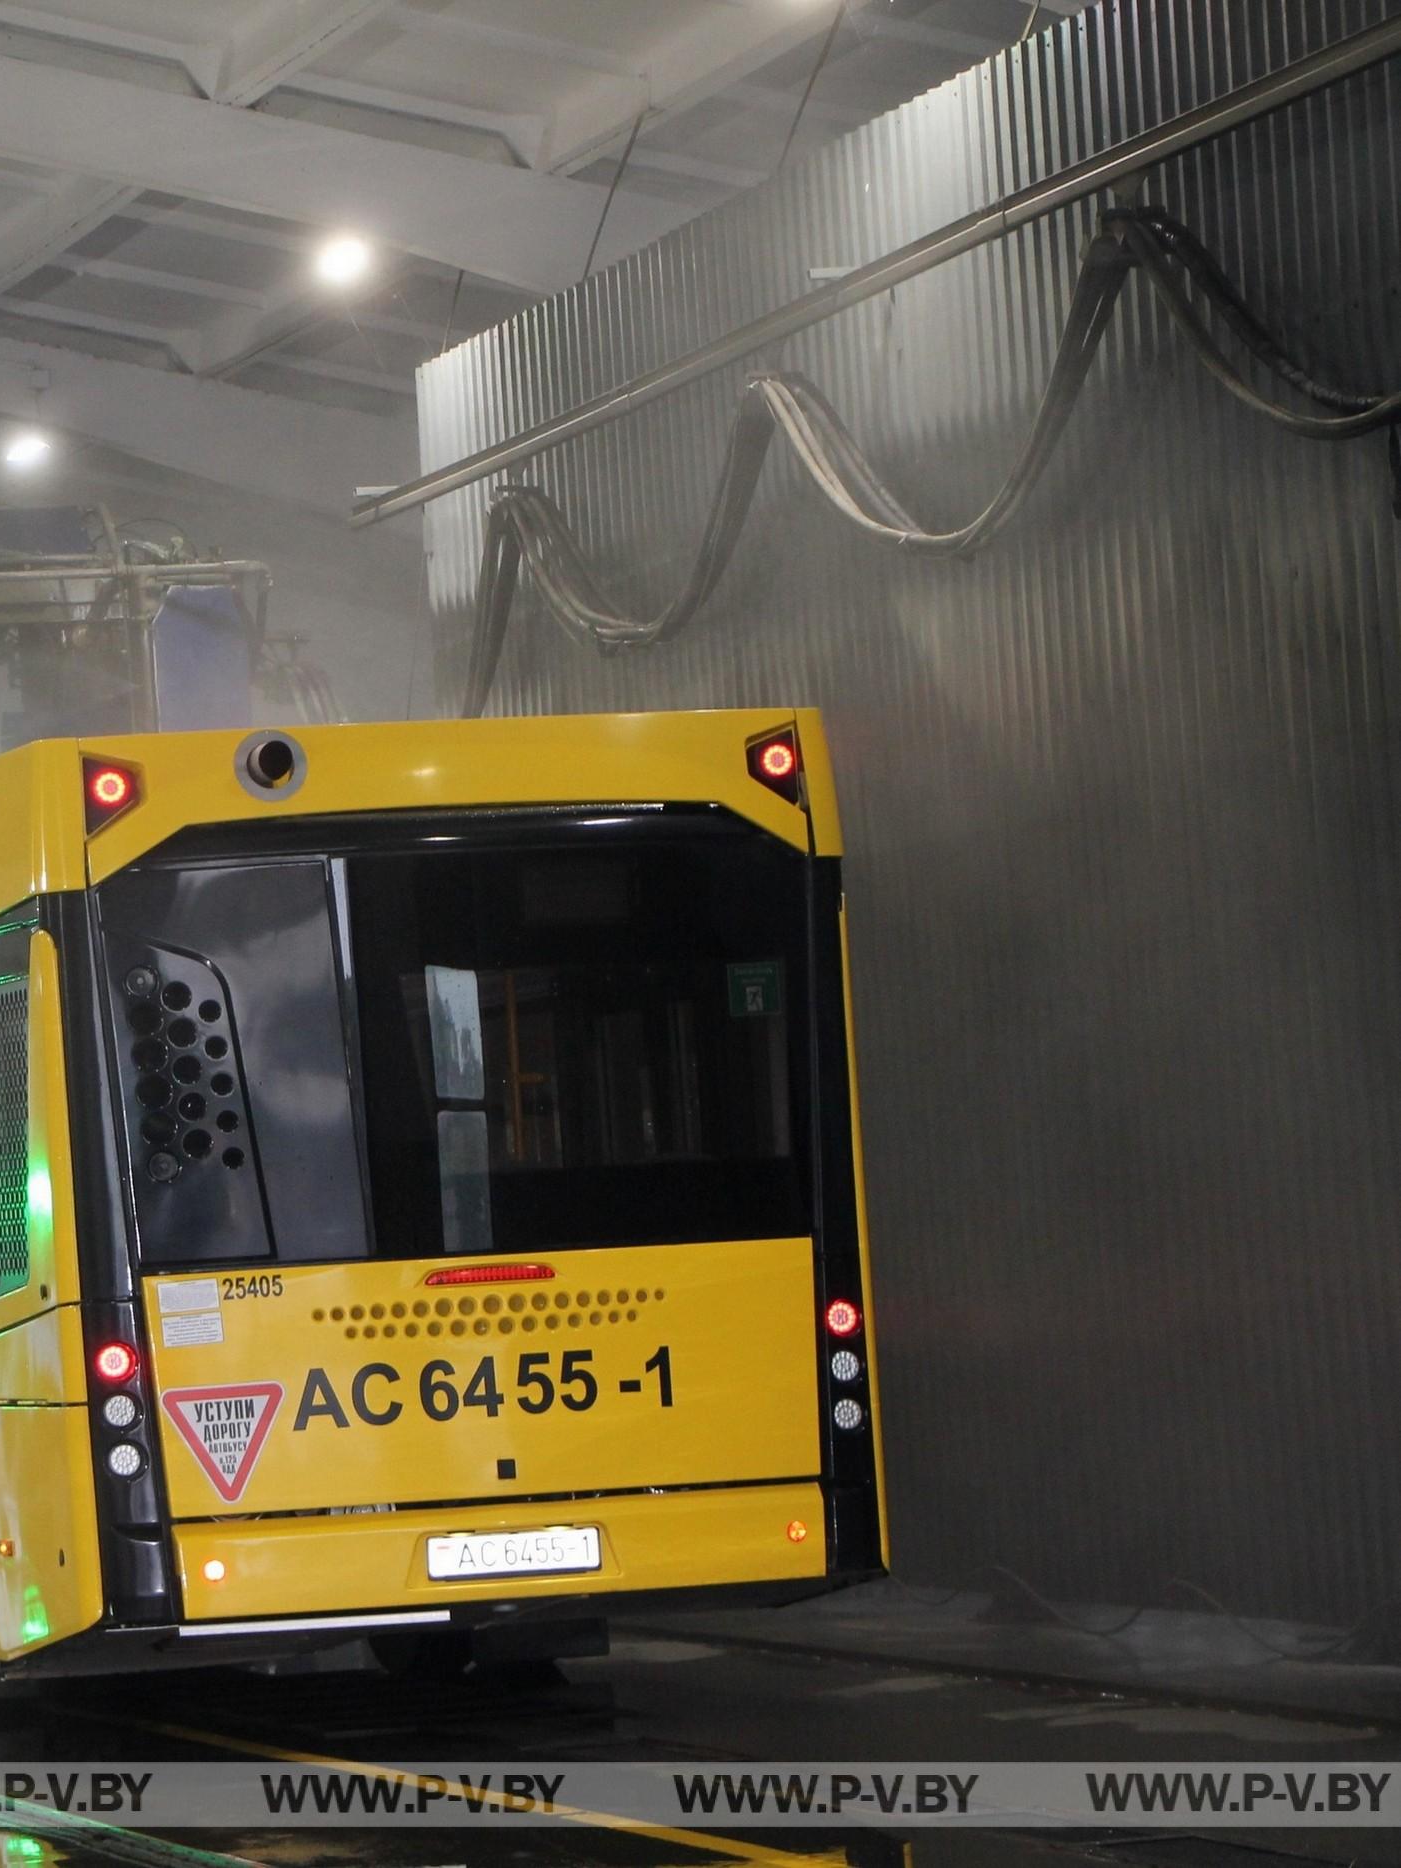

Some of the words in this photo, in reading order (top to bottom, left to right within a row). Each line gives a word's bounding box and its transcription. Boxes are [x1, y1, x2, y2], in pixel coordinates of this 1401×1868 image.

[221, 1274, 284, 1301] 25405
[193, 1398, 255, 1423] УСТУПИ
[203, 1421, 251, 1443] ДОРОГУ
[208, 1441, 247, 1454] АВТОБУСУ
